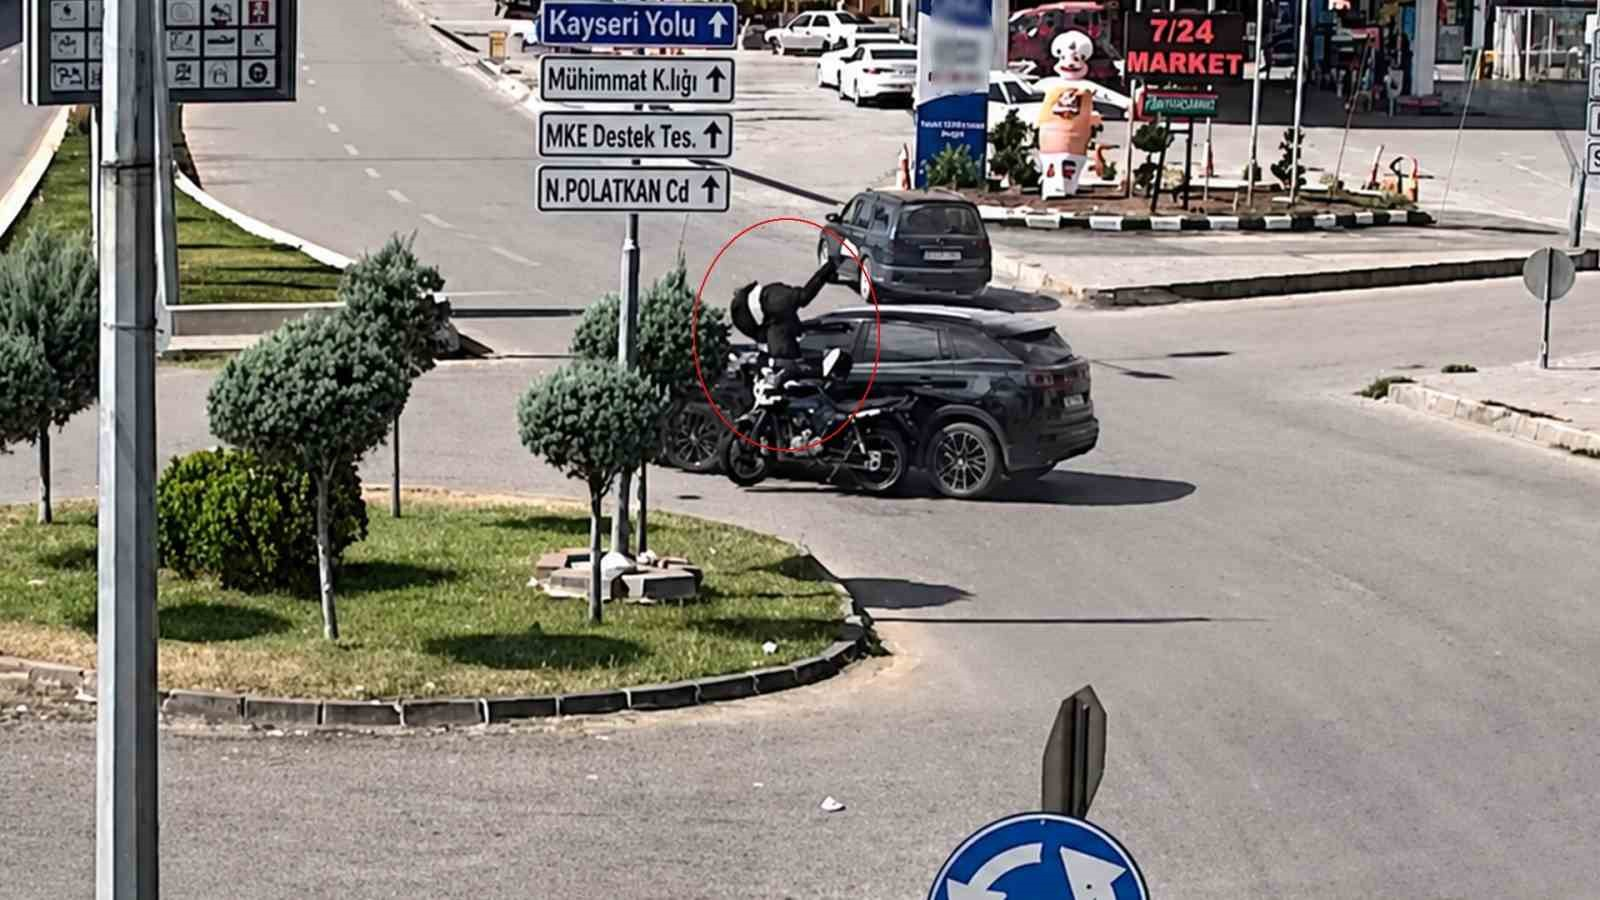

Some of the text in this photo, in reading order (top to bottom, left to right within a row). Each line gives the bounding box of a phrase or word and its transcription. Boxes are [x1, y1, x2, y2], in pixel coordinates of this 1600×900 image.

[549, 9, 696, 41] Kayseri Yolu
[1150, 18, 1215, 44] 7/24
[1127, 51, 1243, 76] MARKET
[549, 66, 698, 98] Mühimmat K.lığı
[546, 123, 697, 149] MKE Destek Tes.
[545, 178, 690, 204] N.POLATKAN Cd
